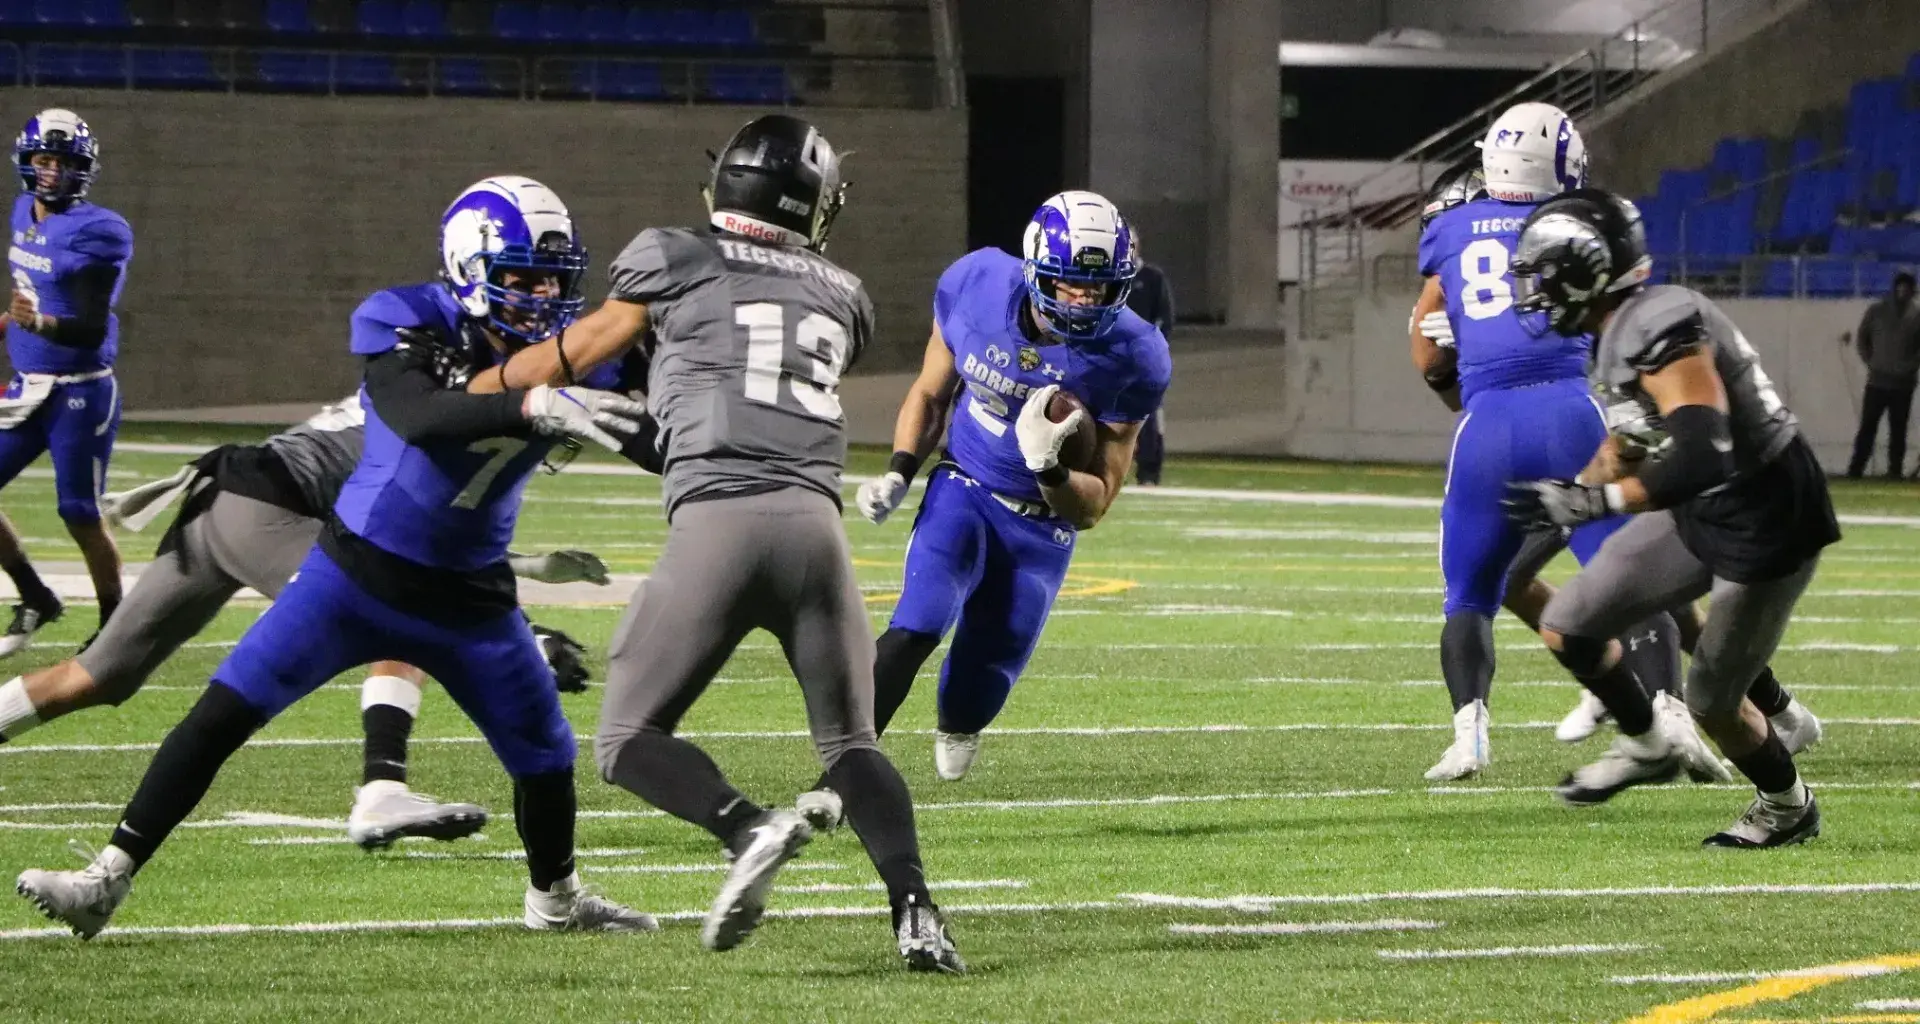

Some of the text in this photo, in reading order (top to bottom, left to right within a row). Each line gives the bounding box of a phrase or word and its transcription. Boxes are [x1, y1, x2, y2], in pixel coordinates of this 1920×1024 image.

[1495, 129, 1525, 147] 87
[724, 215, 788, 243] Riddell
[1460, 238, 1534, 320] 8
[735, 302, 847, 421] 13
[963, 353, 1038, 400] BORRE
